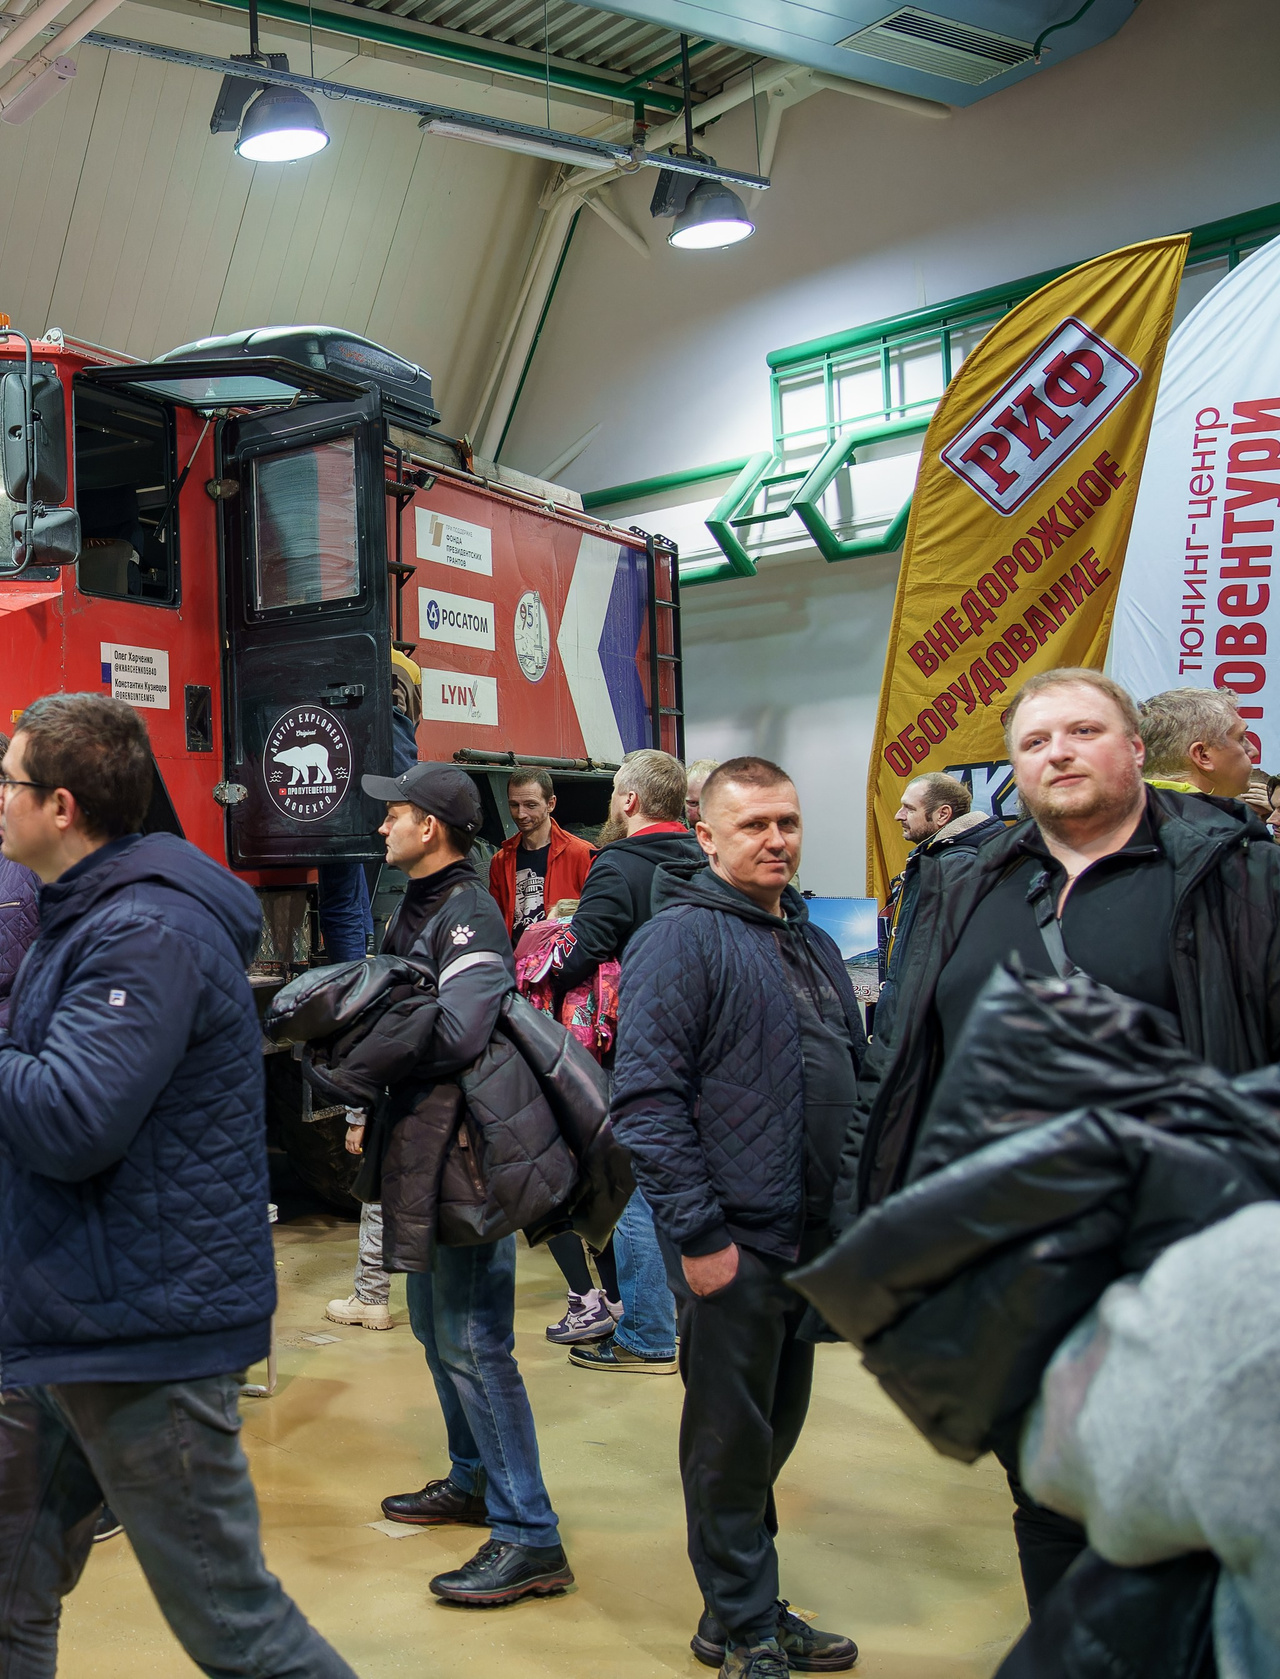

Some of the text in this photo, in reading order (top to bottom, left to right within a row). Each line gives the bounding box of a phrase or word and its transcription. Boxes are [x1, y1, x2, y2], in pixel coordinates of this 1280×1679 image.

[959, 349, 1108, 496] РИФ
[445, 534, 463, 545] ФОНДА
[446, 544, 483, 561] ПРЕЗИДЕНТСКИХ
[446, 555, 467, 567] ГРАНТОВ
[907, 450, 1128, 679] ВНЕДОРОЖНОЕ
[441, 608, 489, 634] РОСАТОМ
[114, 650, 154, 664] Олег Харченко
[884, 547, 1112, 778] ОБОРУДОВАНИЕ
[114, 678, 144, 690] Константин
[441, 680, 478, 708] LYNX
[270, 712, 344, 754] ARCTIC EXPLORERS
[287, 785, 337, 796] ПРОПУТЕШЕСТВИЯ
[852, 984, 872, 997] 25
